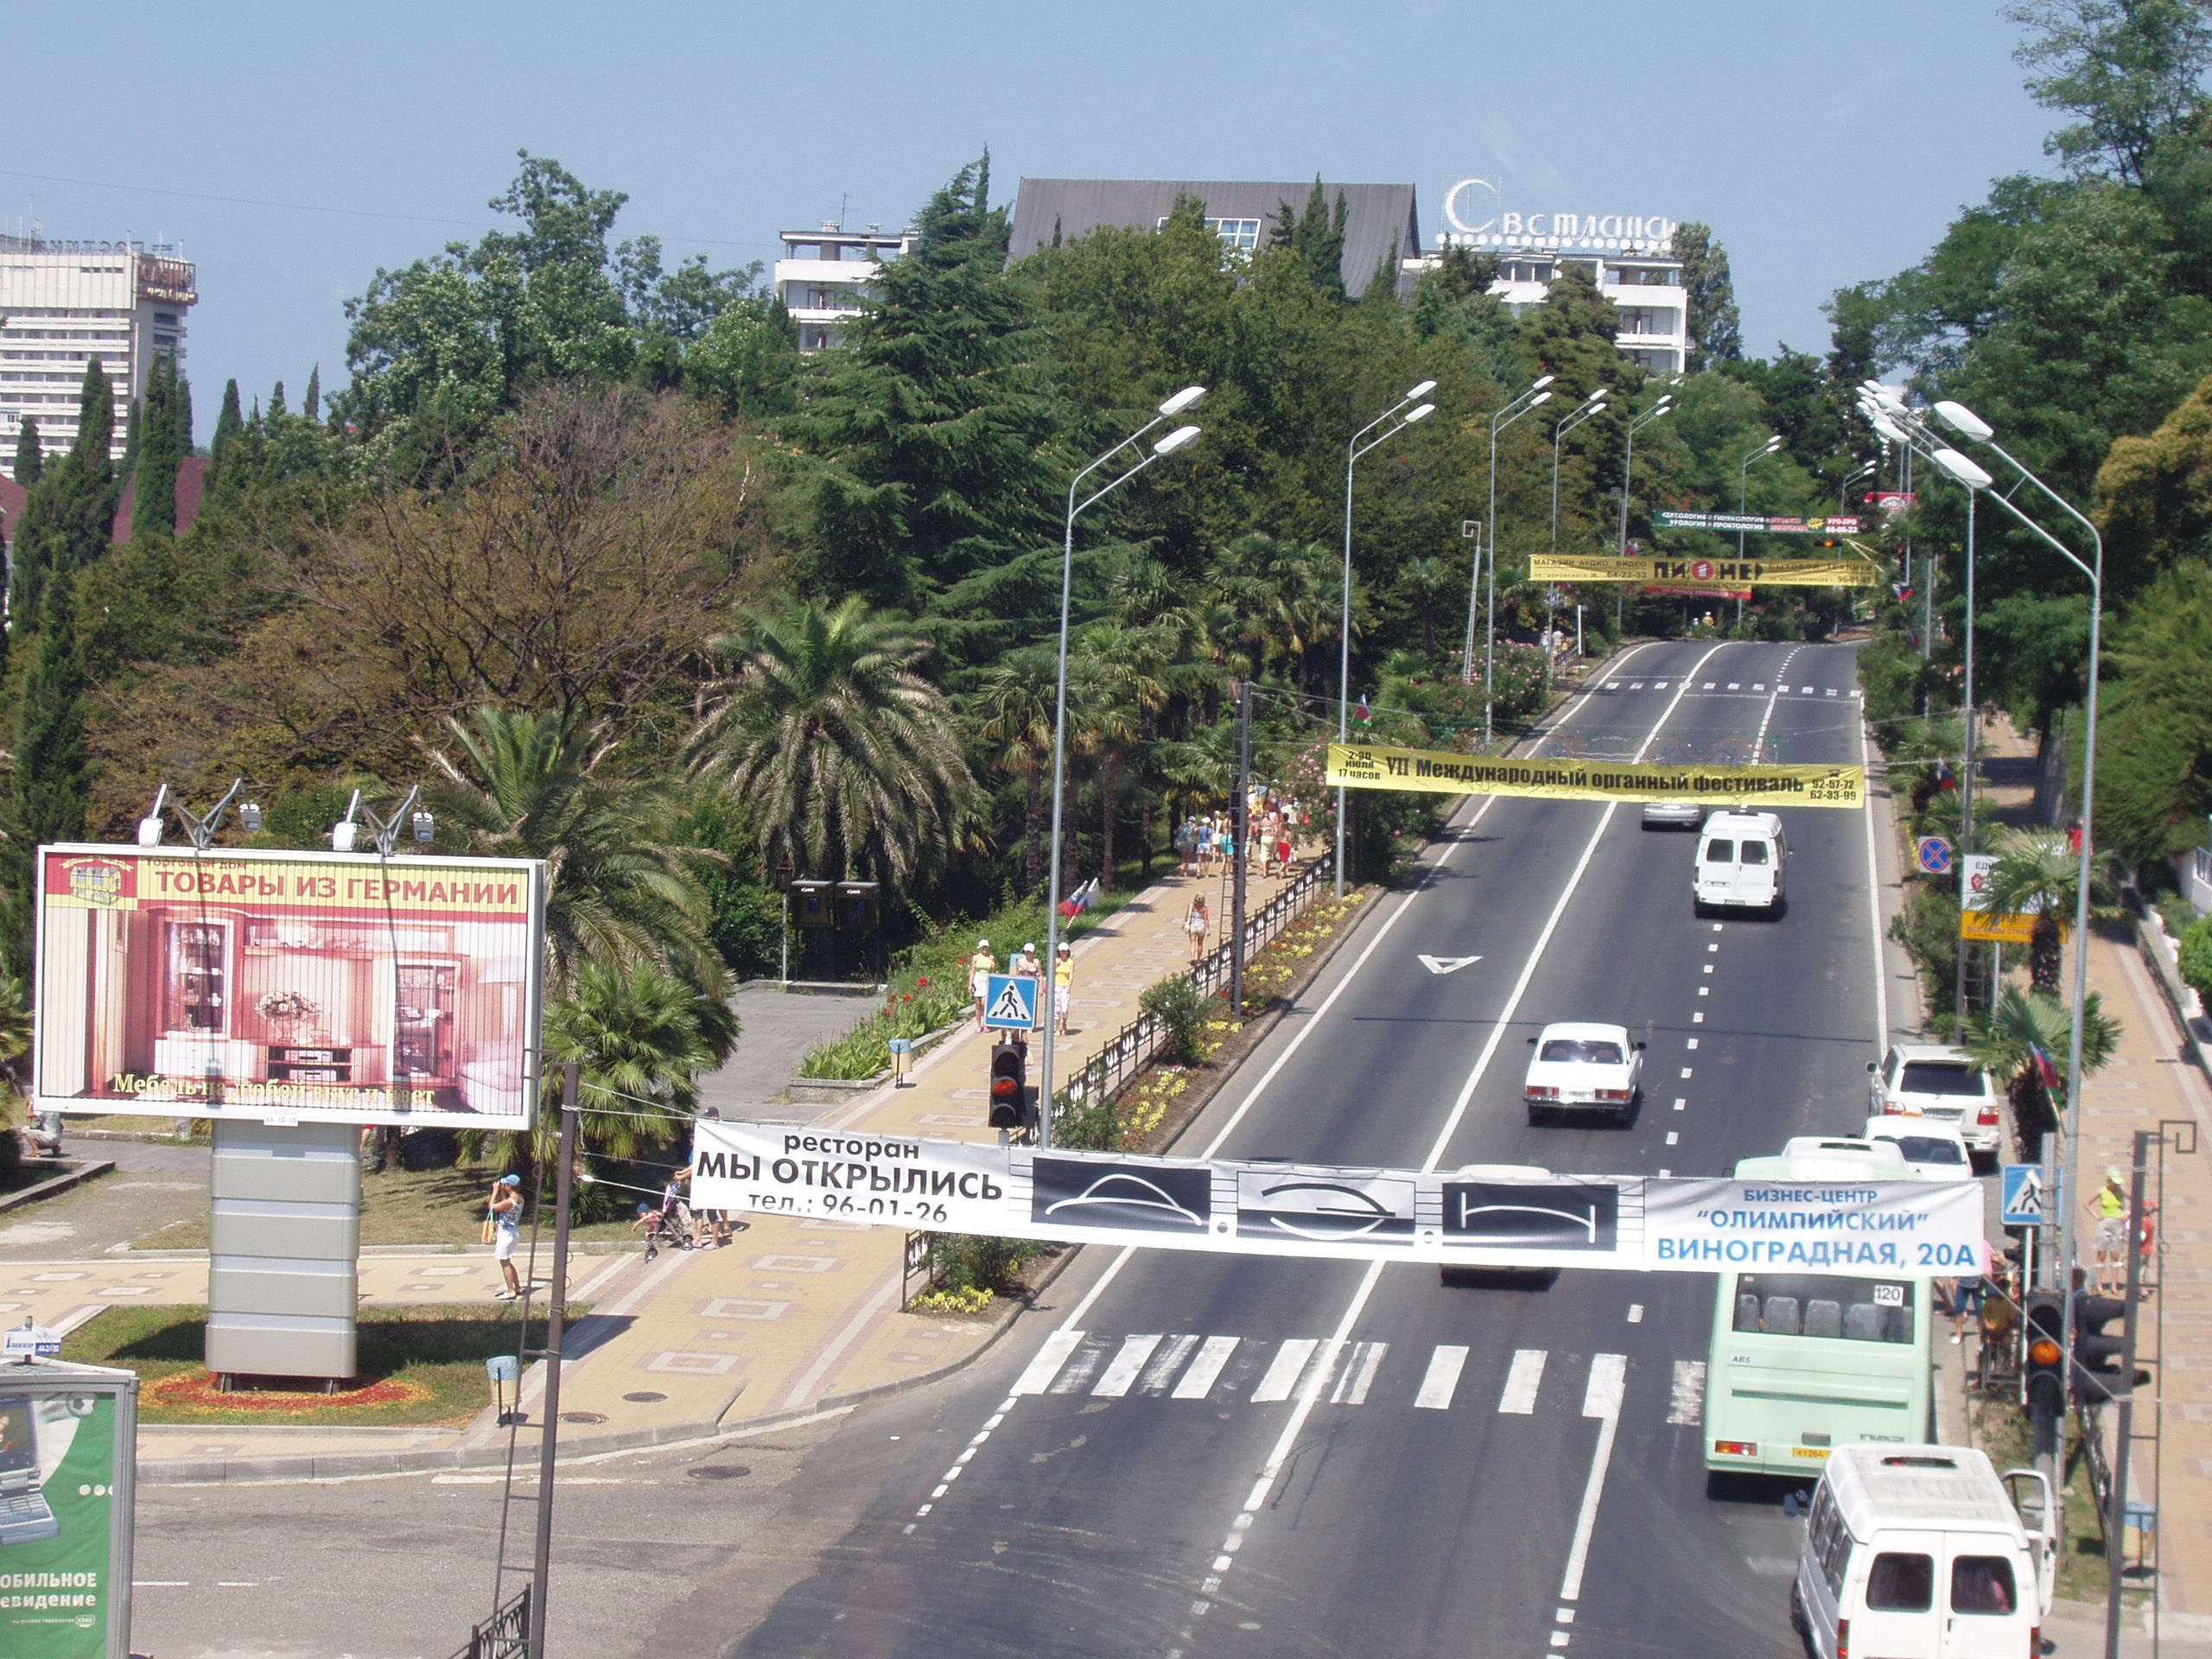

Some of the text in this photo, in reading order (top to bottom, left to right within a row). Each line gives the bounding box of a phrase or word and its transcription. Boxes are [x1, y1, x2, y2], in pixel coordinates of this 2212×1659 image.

[1338, 768, 1381, 780] 17 часов
[1385, 756, 1804, 793] VII Международный органный фестиваль
[155, 870, 518, 905] ТОВАРЫ ИЗ ГЕРМАНИИ
[113, 1072, 197, 1096] Мебель
[201, 1081, 226, 1096] на
[232, 1077, 307, 1101] любой
[784, 1134, 919, 1162] ресторан
[696, 1151, 1003, 1201] МЫ ОТКРЫЛИСЬ
[748, 1192, 948, 1224] тел.: 96-01-26
[1744, 1189, 1878, 1205] БИЗНЕС-ЦЕНТР
[1657, 1237, 1976, 1268] ВИНОГРАДНАЯ, 20А
[1876, 1287, 1902, 1301] 120
